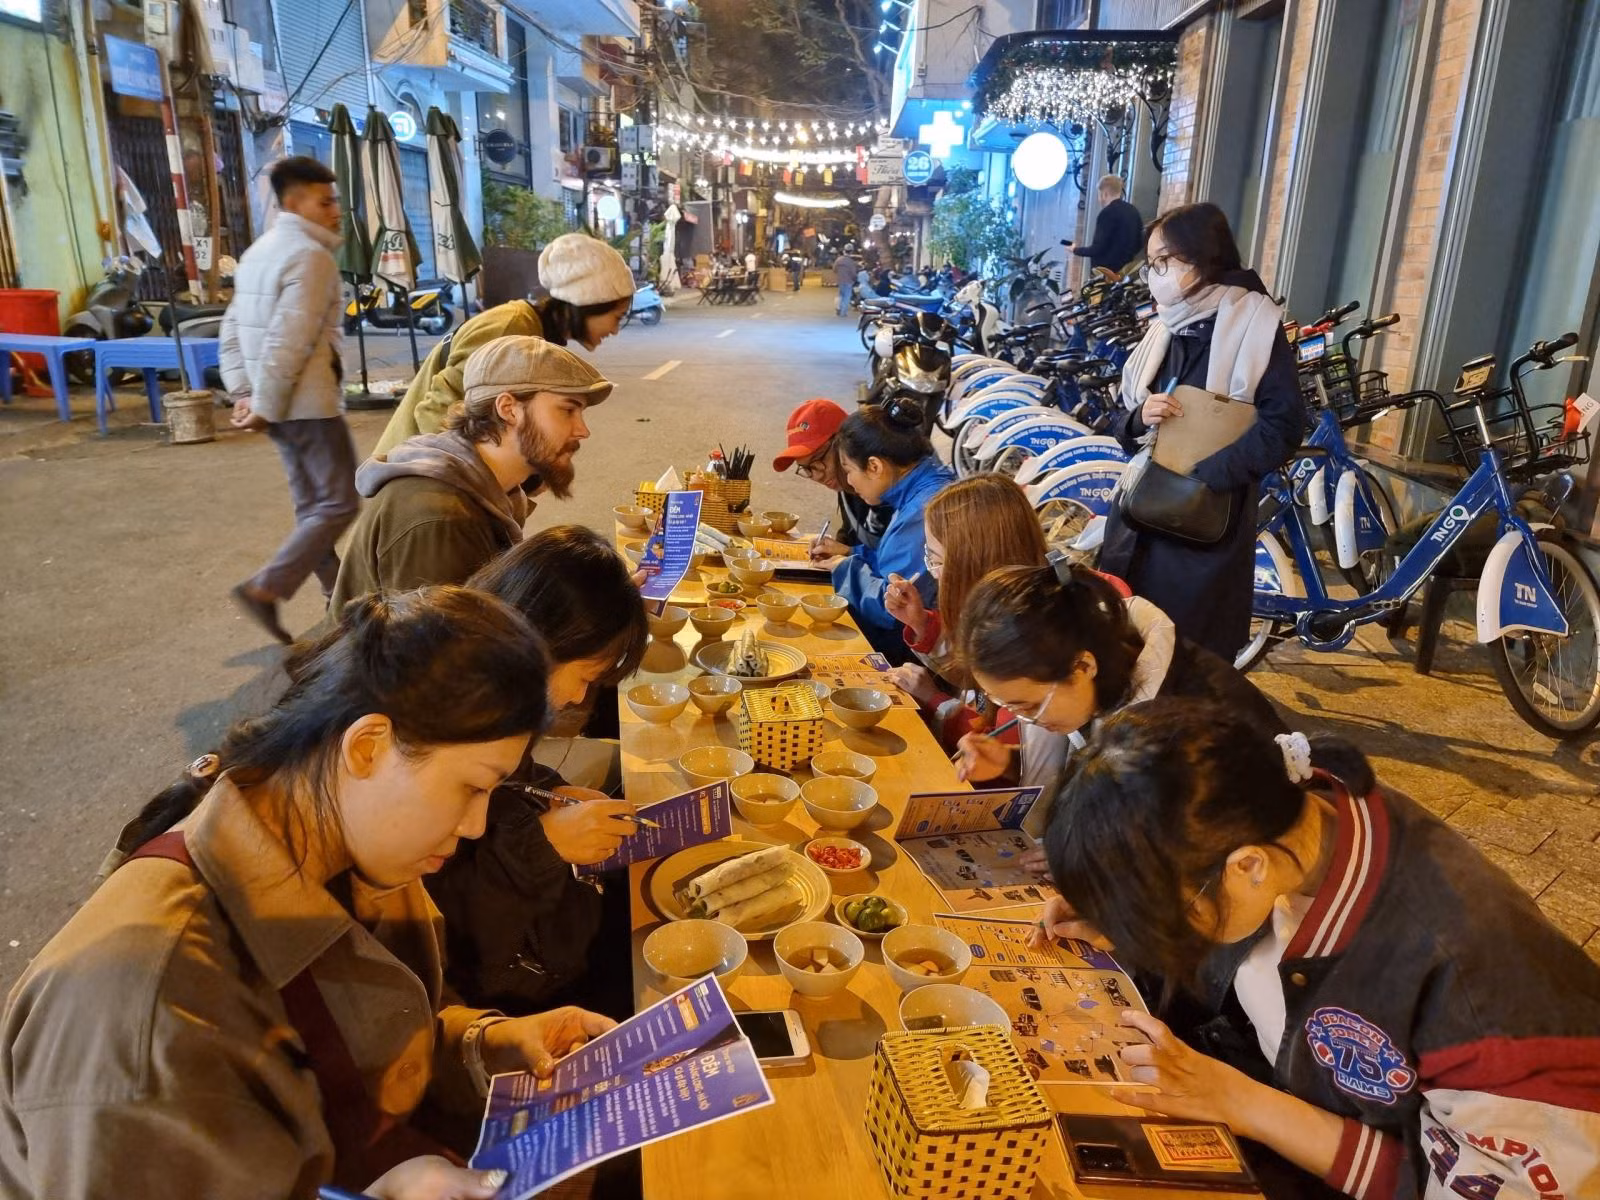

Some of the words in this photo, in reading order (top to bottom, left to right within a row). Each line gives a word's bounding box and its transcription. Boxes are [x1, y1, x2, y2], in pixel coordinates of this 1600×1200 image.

[907, 156, 929, 170] 26
[1430, 504, 1471, 542] TNGO
[1514, 582, 1537, 602] TN
[1319, 1014, 1385, 1046] DEACON
[699, 1053, 720, 1078] ĐÊM
[1330, 1039, 1384, 1083] 75
[1337, 1070, 1391, 1099] RAMS
[1452, 1128, 1564, 1200] MPIO
